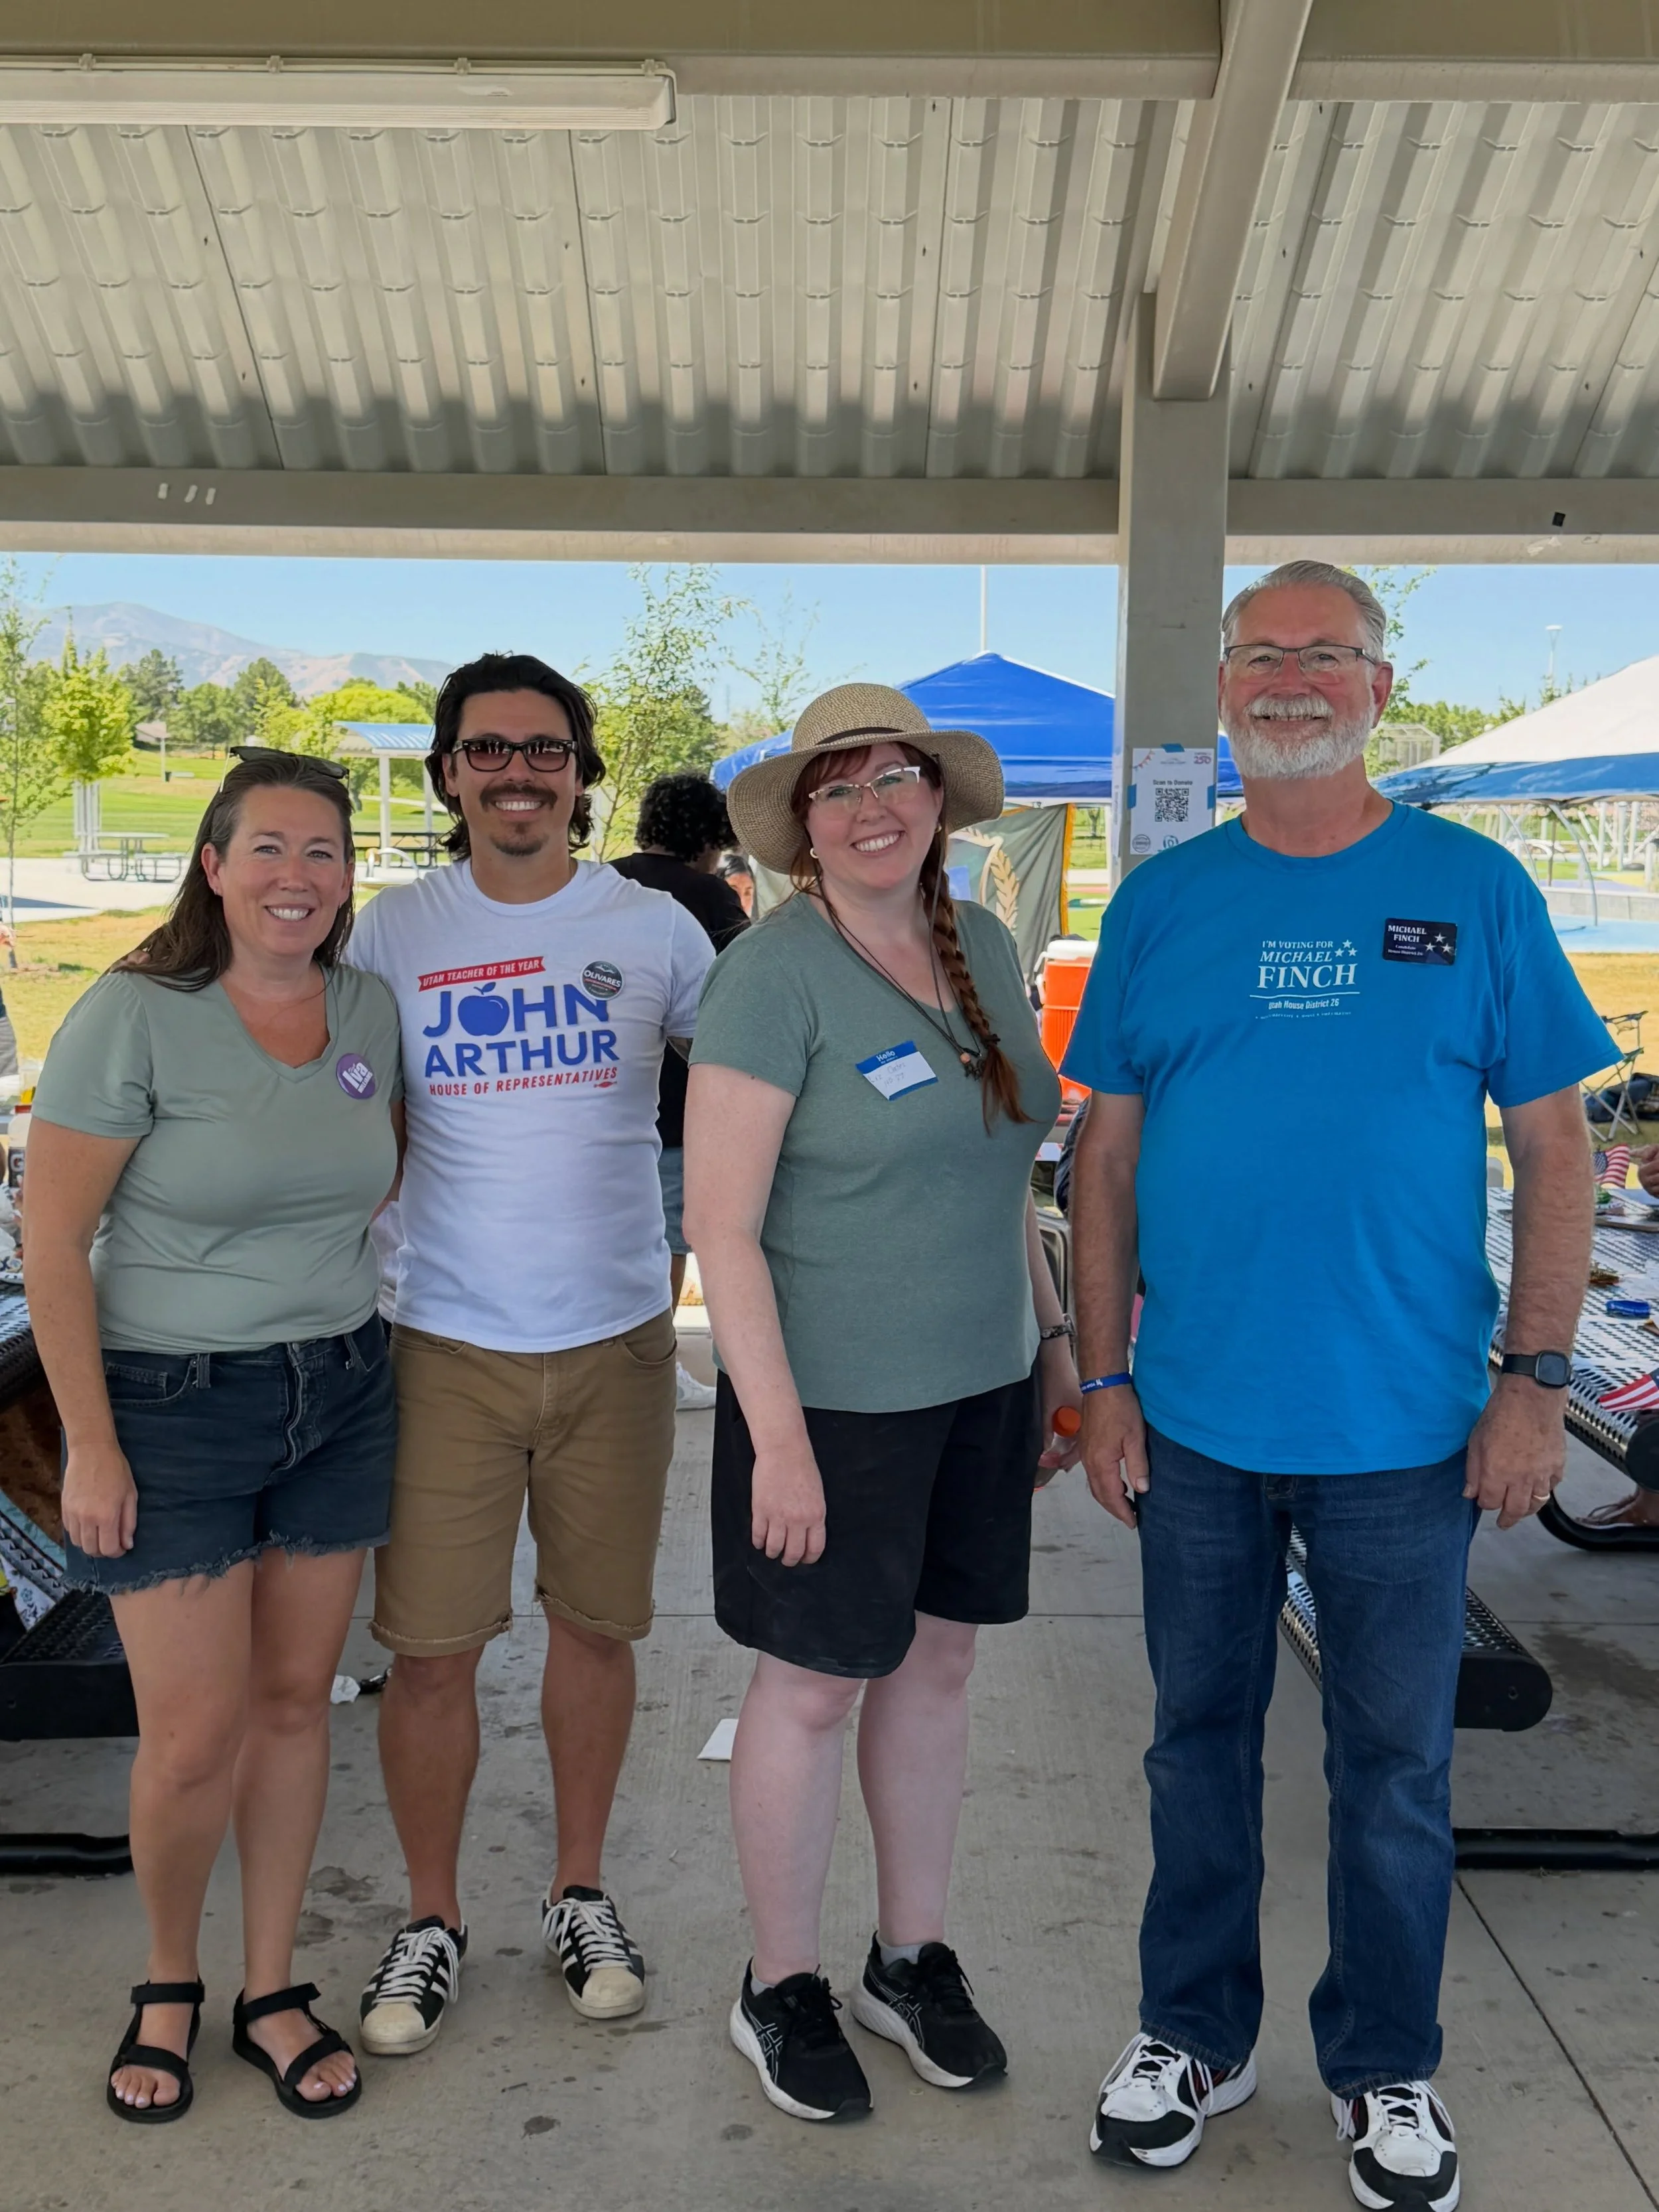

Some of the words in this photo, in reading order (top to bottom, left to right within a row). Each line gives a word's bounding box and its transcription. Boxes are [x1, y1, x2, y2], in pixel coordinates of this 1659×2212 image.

[1388, 924, 1427, 935] MICHAEL
[1279, 940, 1314, 949] VOTING
[1394, 934, 1419, 942] FINCH
[1260, 951, 1333, 964] MICHAEL
[423, 974, 445, 987] UTAH
[447, 968, 484, 982] TEACHER
[486, 966, 498, 976] OF
[500, 962, 516, 974] THE
[518, 960, 540, 972] YEAR
[584, 970, 622, 988] OLIVARES
[1257, 963, 1358, 989] FINCH
[1268, 1000, 1283, 1009] Utah
[1283, 999, 1304, 1009] House
[1305, 999, 1329, 1009] District
[1330, 998, 1340, 1007] 26
[425, 1029, 620, 1078] ARTHUR
[876, 1051, 896, 1062] Hello
[430, 1083, 467, 1096] HOUSE
[474, 1082, 490, 1094] OF
[496, 1067, 618, 1092] REPRESENTATIVES
